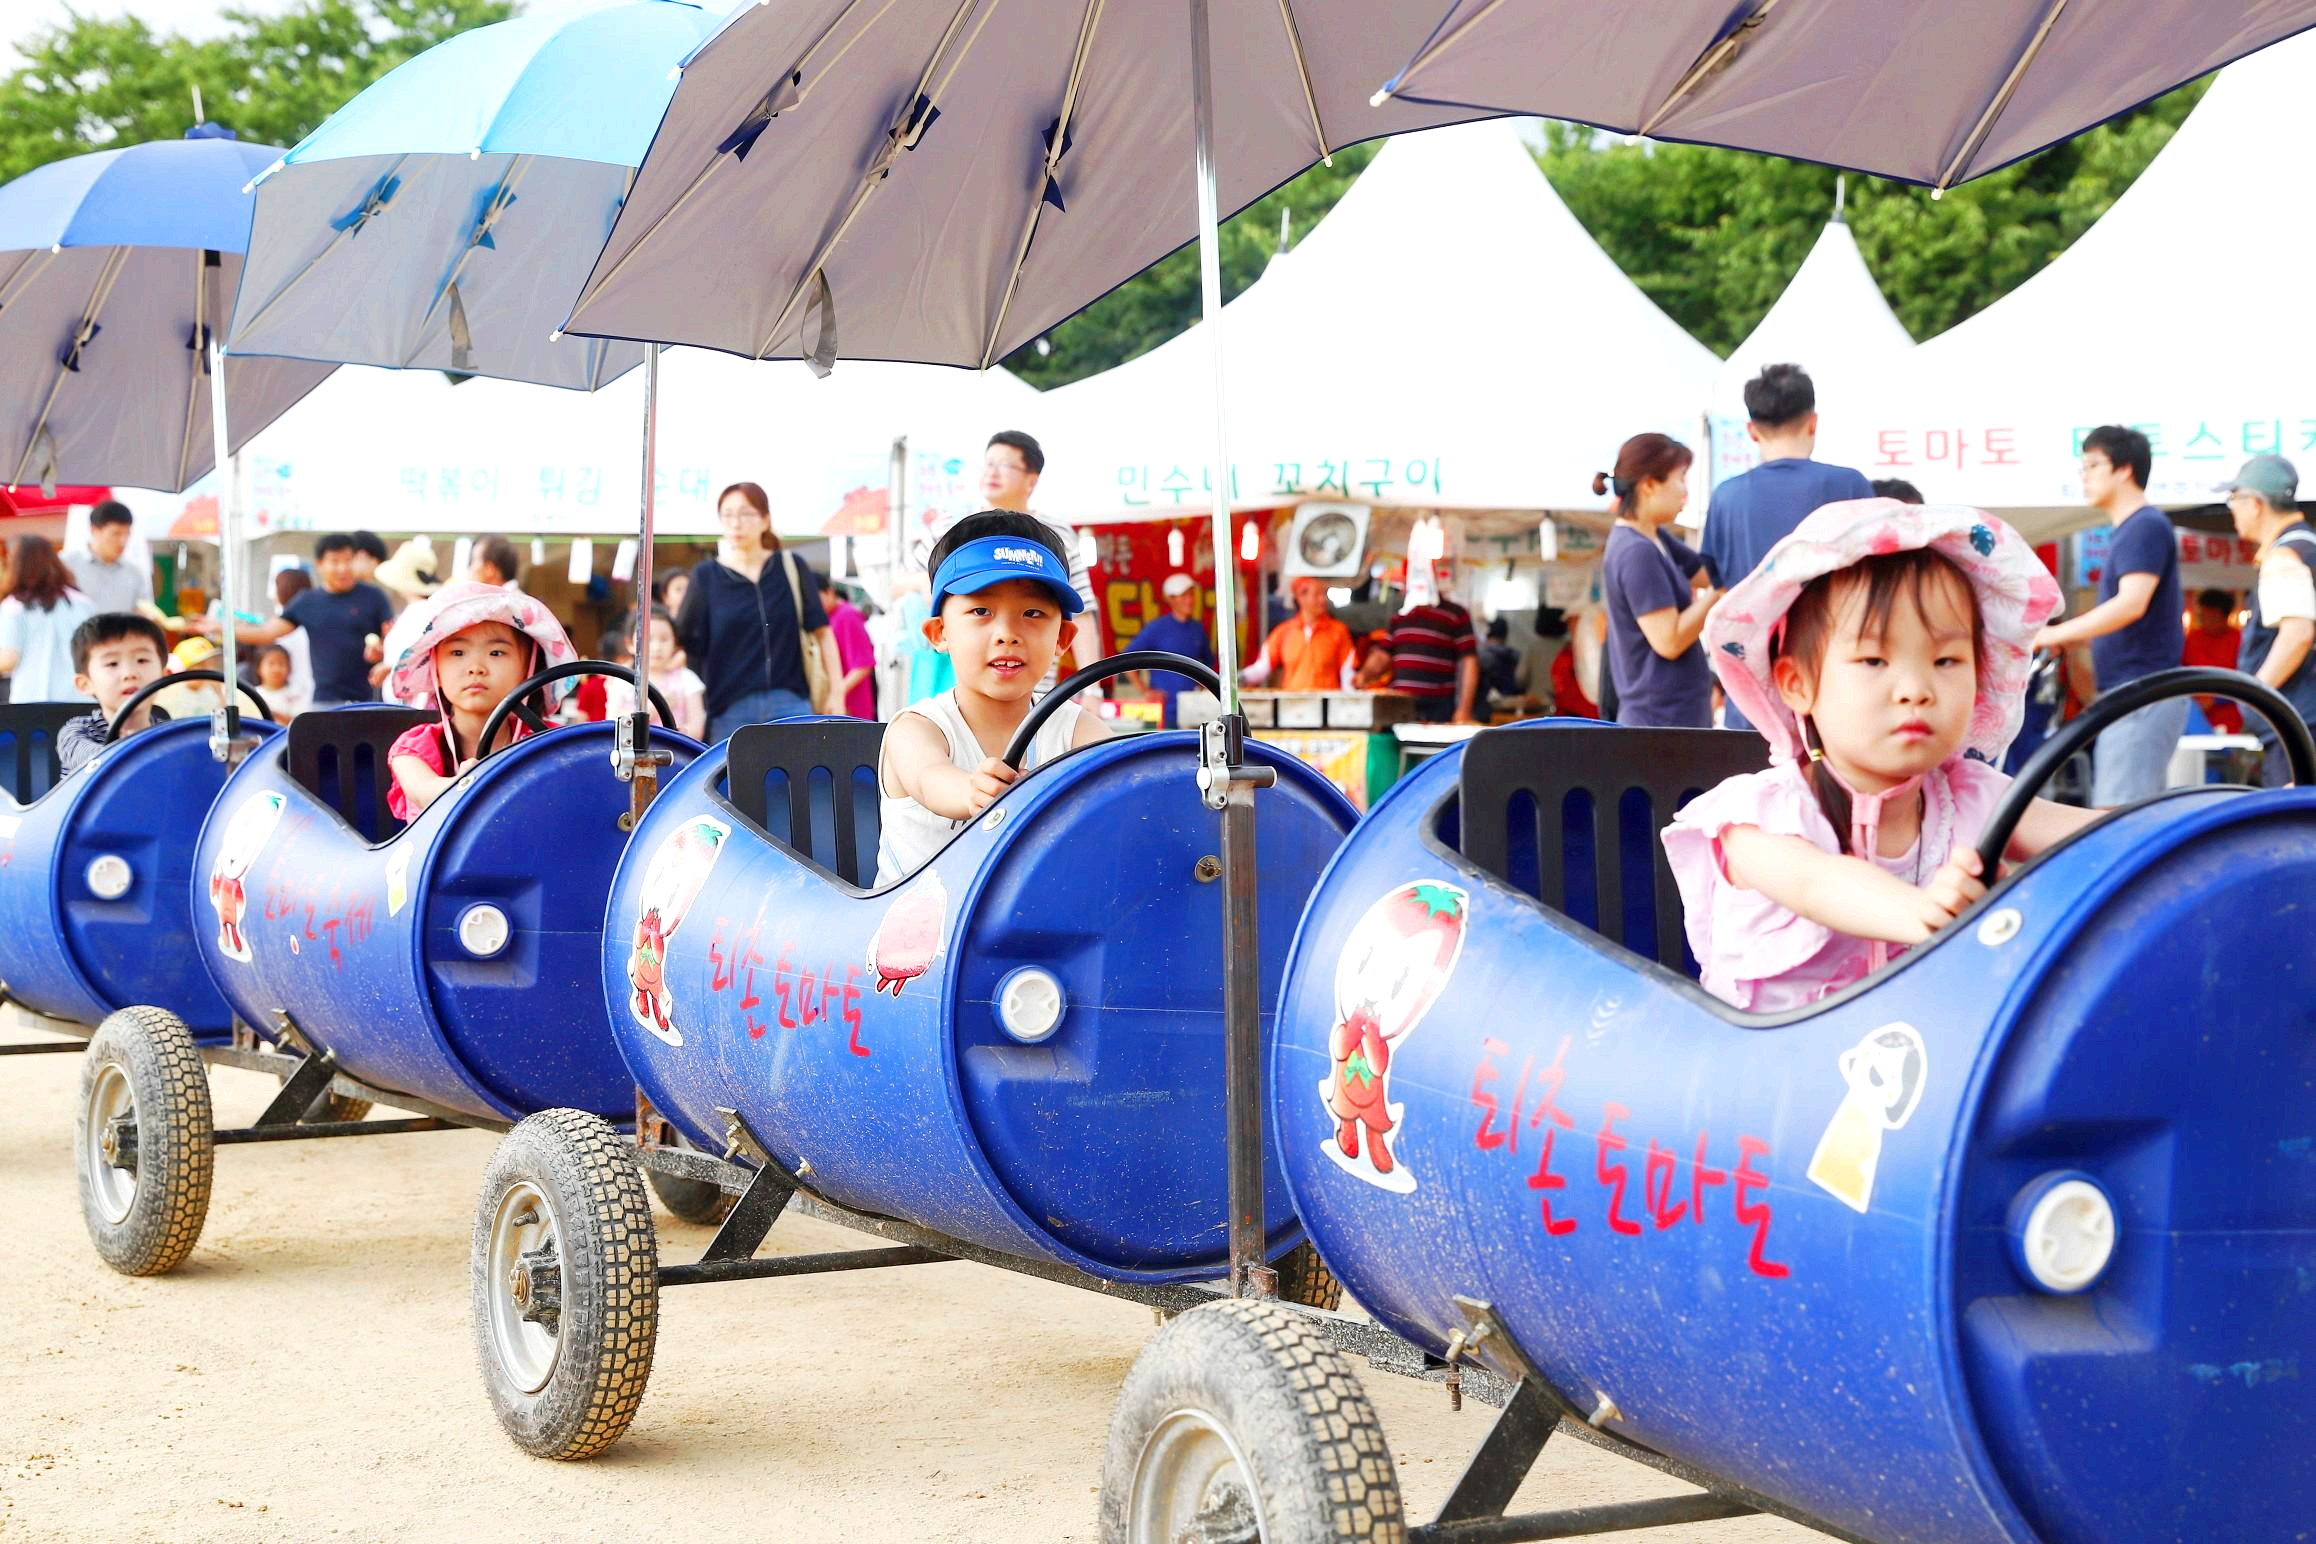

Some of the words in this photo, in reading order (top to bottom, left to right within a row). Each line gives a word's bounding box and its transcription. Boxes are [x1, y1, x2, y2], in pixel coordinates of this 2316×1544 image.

[1873, 427, 2021, 470] 토마토
[400, 465, 500, 505] 떡볶이
[537, 464, 602, 506] 튀김
[1271, 457, 1441, 499] 꼬치구이
